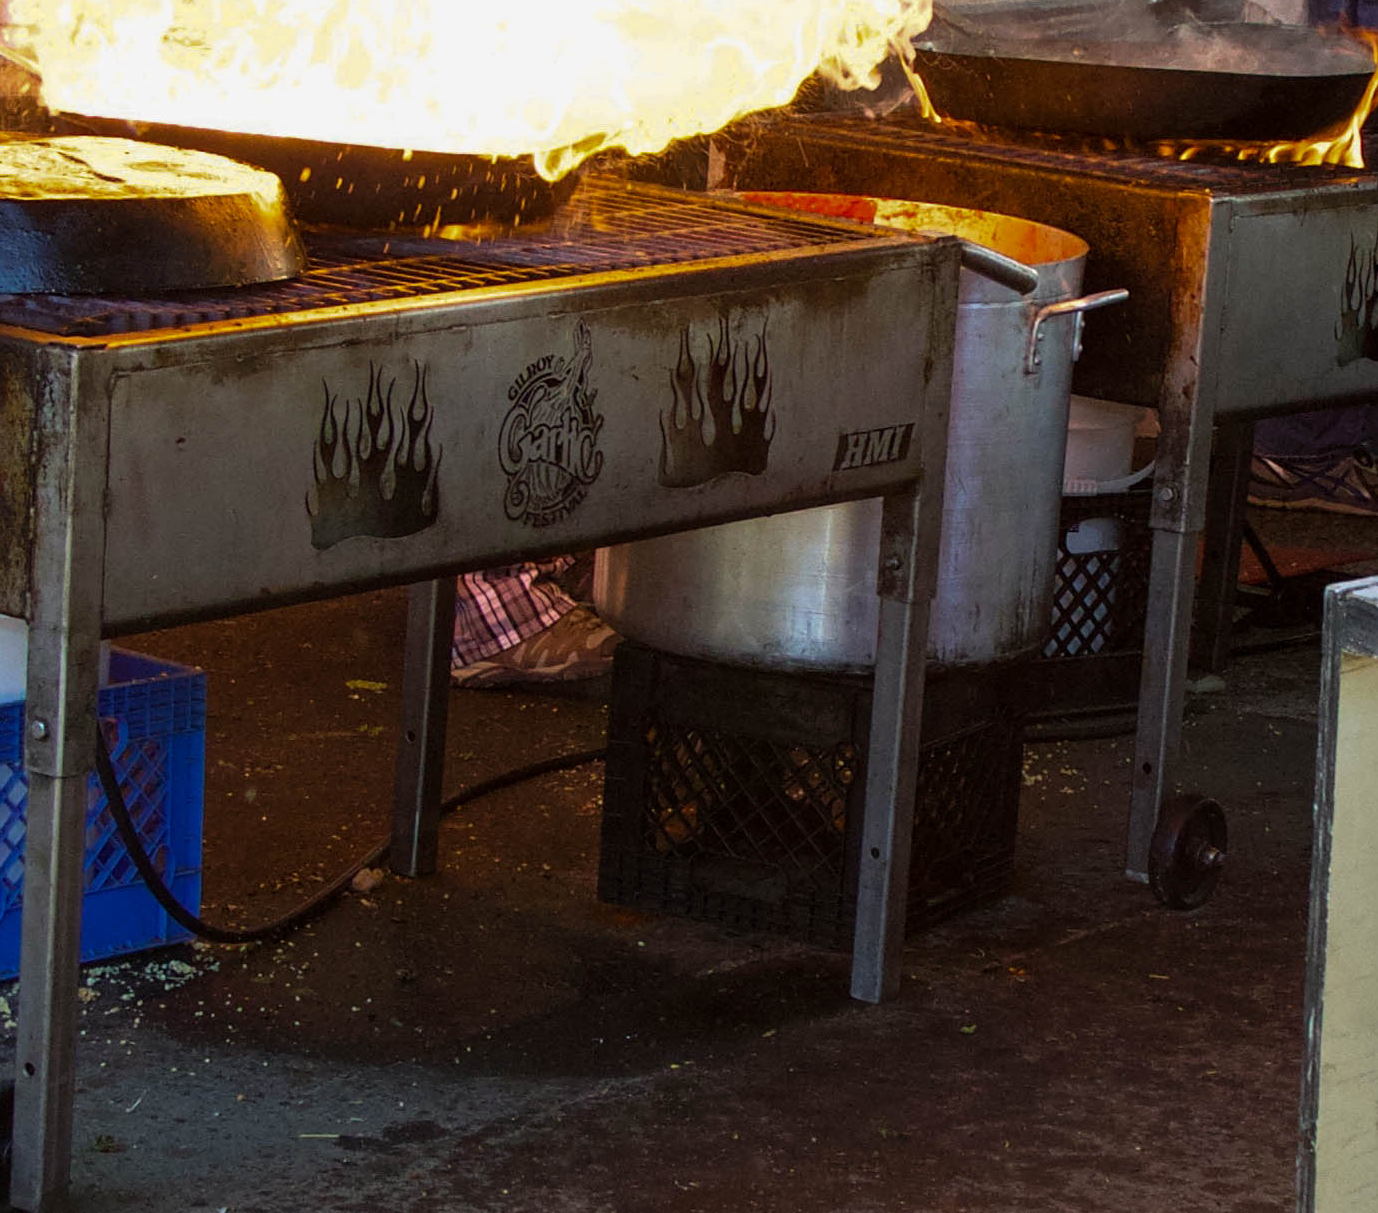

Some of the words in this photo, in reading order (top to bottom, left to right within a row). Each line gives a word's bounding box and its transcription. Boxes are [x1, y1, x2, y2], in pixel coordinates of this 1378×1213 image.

[507, 353, 555, 402] GILROY
[498, 385, 605, 486] Garlic
[839, 425, 908, 470] HMI
